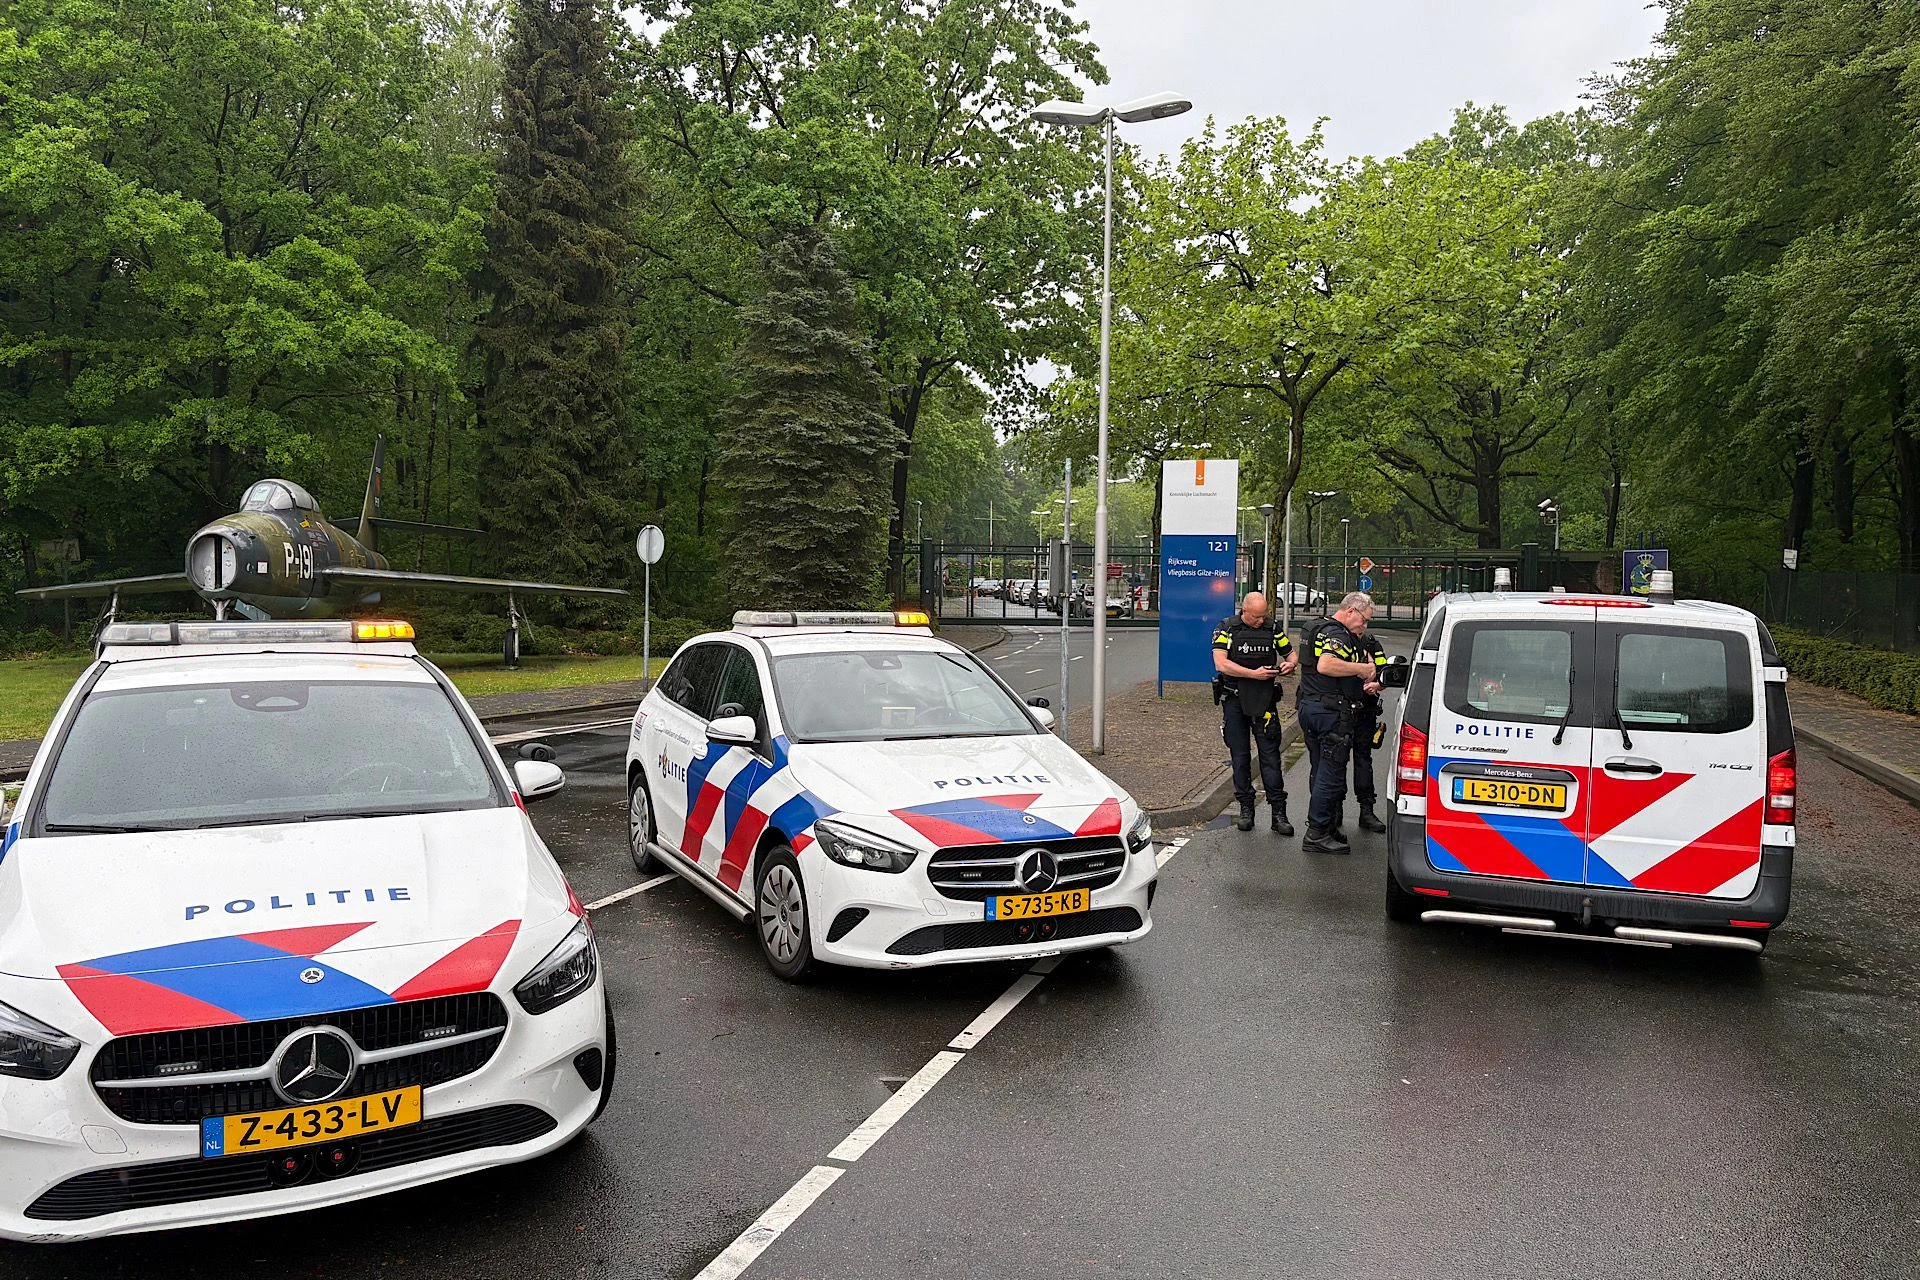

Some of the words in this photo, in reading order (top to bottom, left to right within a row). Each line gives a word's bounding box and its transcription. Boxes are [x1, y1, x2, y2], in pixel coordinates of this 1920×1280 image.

[1208, 541, 1229, 552] 121
[283, 542, 314, 579] P-191
[1168, 557, 1197, 566] Rijksweg
[1167, 569, 1196, 578] Vliegbasis
[1197, 569, 1230, 578] Gilze-Rijen
[1238, 642, 1270, 654] POLITIE
[1455, 723, 1534, 739] POLITIE
[657, 752, 686, 783] POLITIE
[1484, 768, 1533, 778] Mercedes-Benz
[933, 775, 1051, 789] POLITIE
[1471, 782, 1555, 804] L-310-DN
[185, 887, 411, 921] POLITIE
[986, 909, 995, 917] NL
[1002, 892, 1082, 917] S-735-KB
[206, 1140, 222, 1151] NL
[239, 1093, 403, 1147] Z-433-LV
